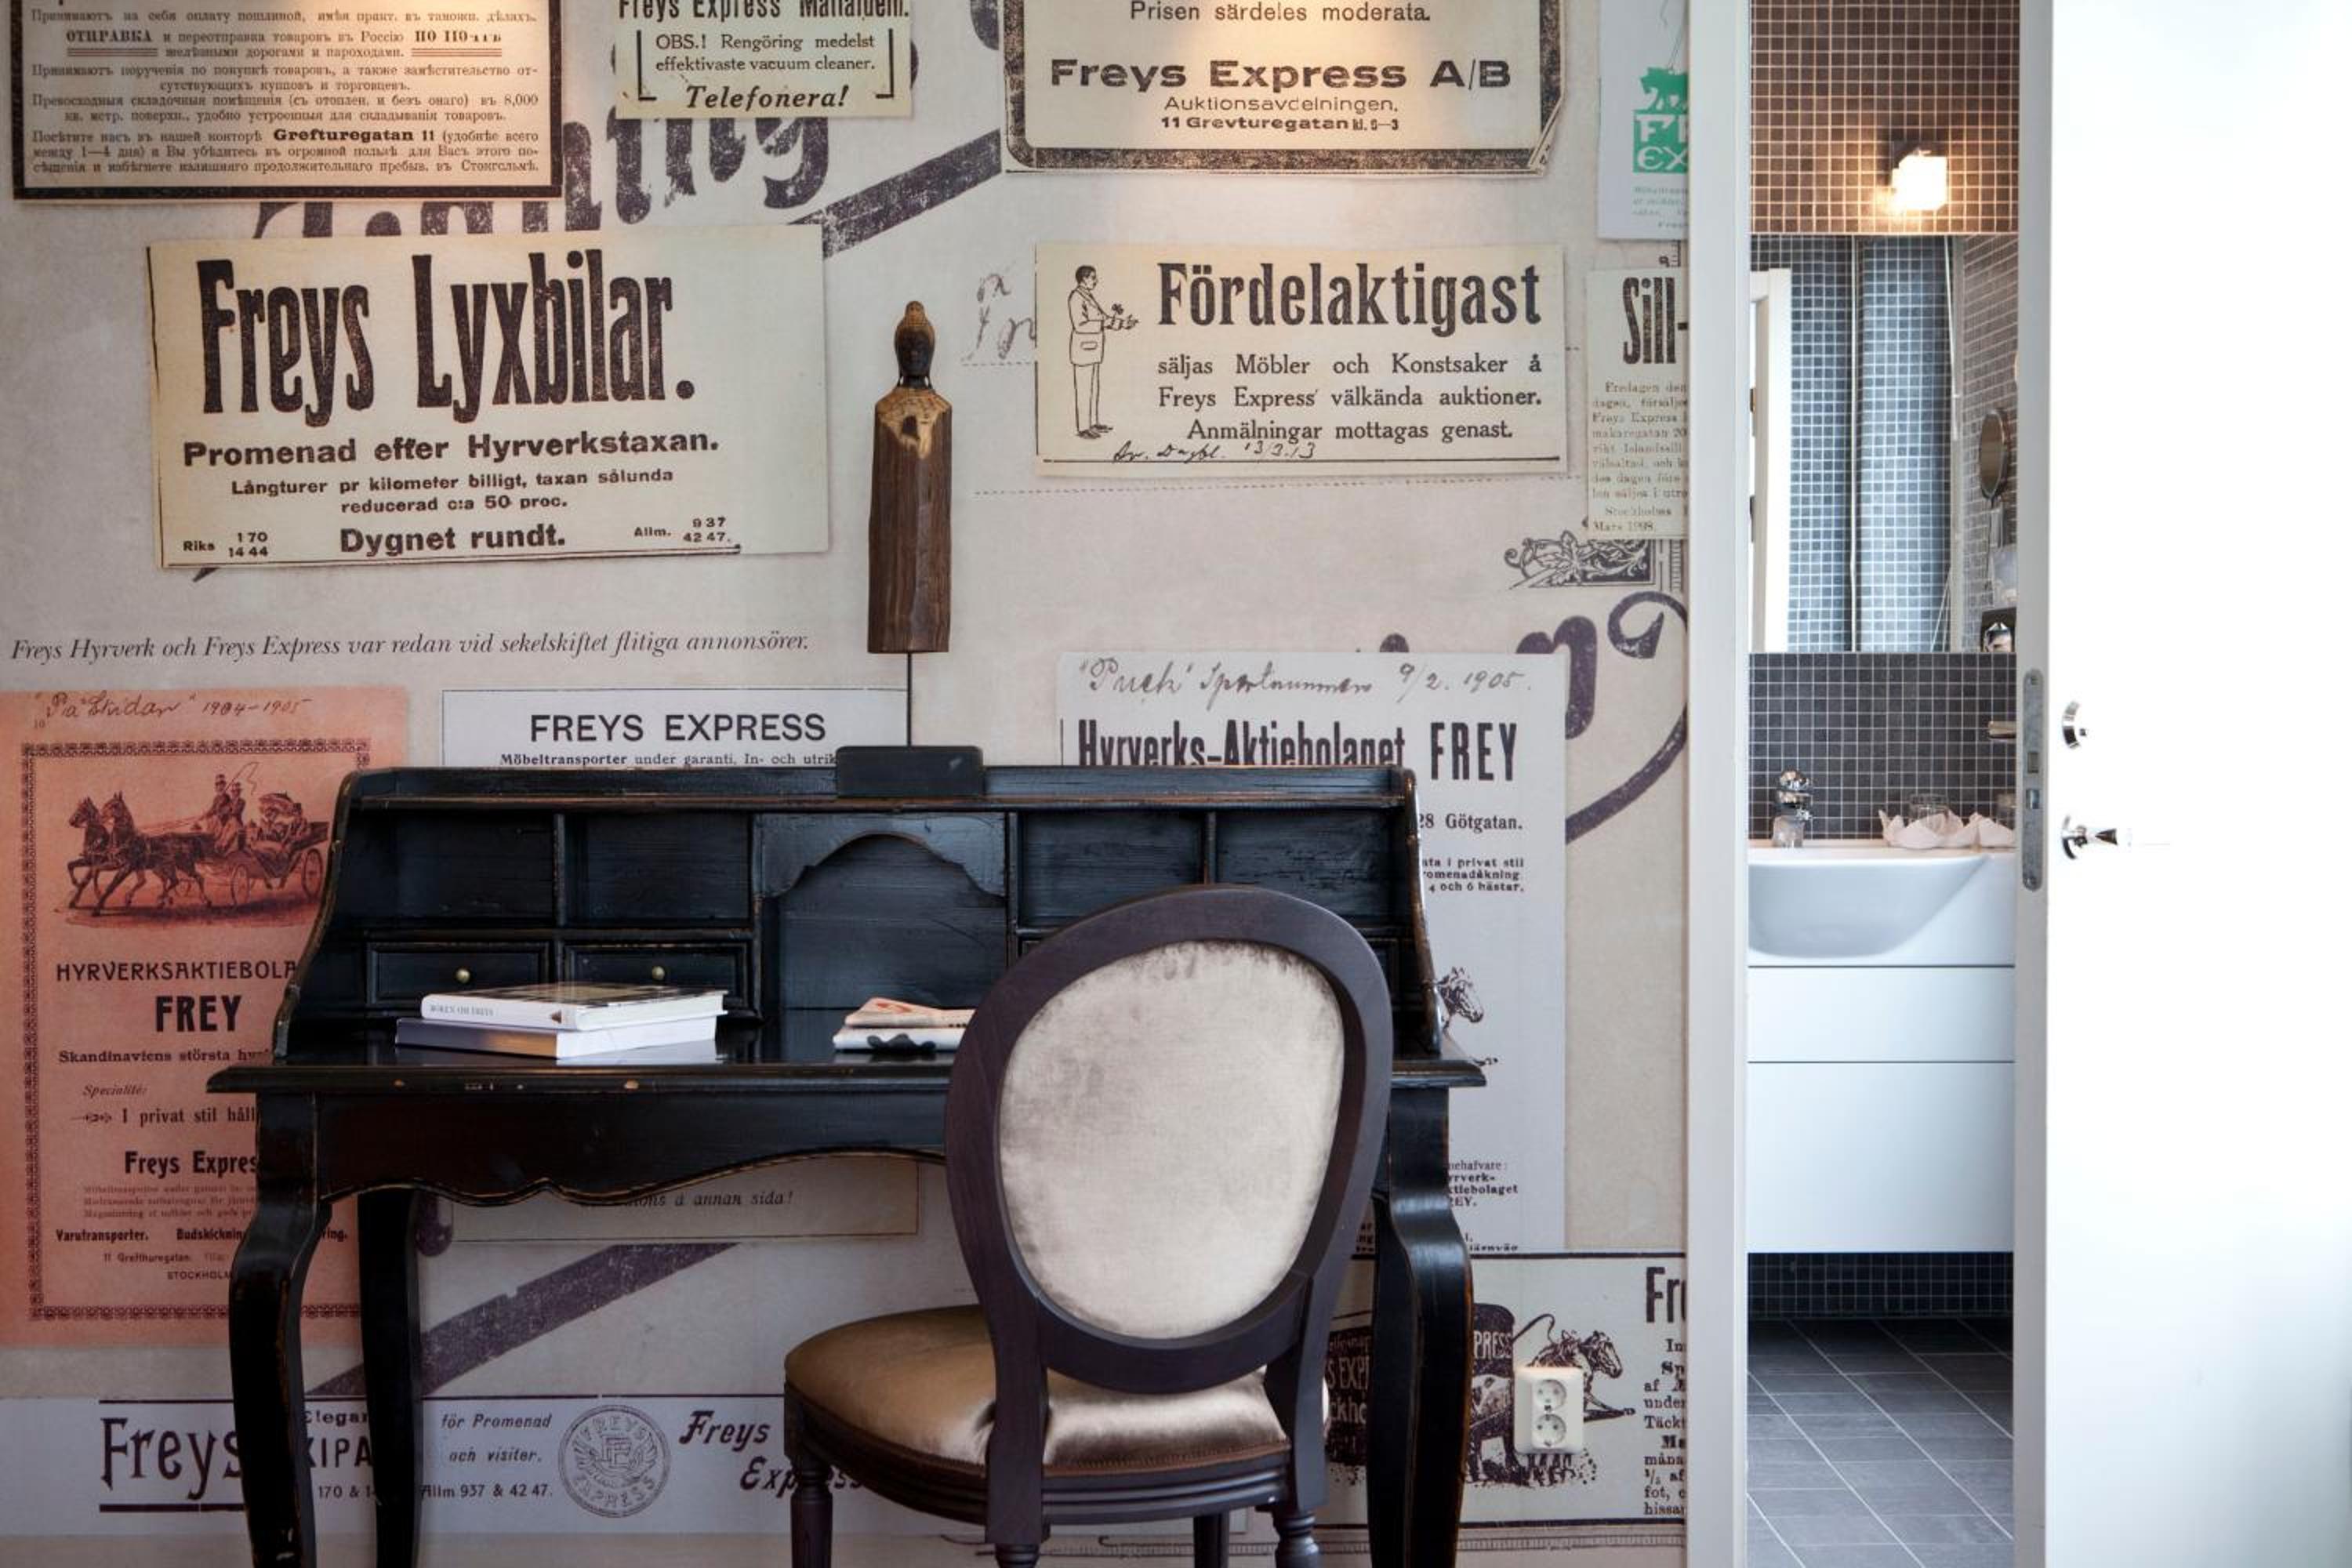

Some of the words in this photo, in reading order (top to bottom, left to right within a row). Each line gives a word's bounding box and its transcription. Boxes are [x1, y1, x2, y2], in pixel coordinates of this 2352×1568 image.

[619, 0, 680, 24] Freys
[692, 0, 781, 23] Express
[1131, 0, 1200, 21] Prisen
[1214, 1, 1308, 21] särdeles
[1322, 1, 1431, 22] moderata.
[65, 29, 153, 43] ОТПРАВКА
[655, 34, 706, 50] OBS.!
[720, 34, 804, 53] Rengöring
[815, 32, 875, 49] medelst
[655, 56, 746, 71] effektivaste
[749, 60, 811, 71] vacuum
[815, 54, 876, 71] cleaner.
[1051, 59, 1187, 93] Freys
[1210, 60, 1407, 94] Express
[1429, 59, 1511, 91] A/B
[503, 93, 539, 108] 8,000
[686, 84, 850, 112] Telefonera!
[1161, 116, 1180, 129] 11
[1185, 116, 1349, 132] Grevturegatan
[273, 129, 414, 143] Grefturegatan
[422, 129, 434, 142] 11
[1156, 262, 1541, 338] Fördelaktigast
[1622, 277, 1688, 365] Sill-
[196, 259, 375, 428] Freys
[412, 248, 696, 425] Lyxbilar.
[1157, 353, 1214, 379] säljas
[1236, 353, 1311, 375] Möbler
[1332, 352, 1370, 375] och
[1392, 351, 1508, 374] Konstsaker
[1528, 353, 1542, 373] å
[1158, 385, 1217, 412] Freys
[1330, 384, 1424, 407] välkända
[1439, 385, 1542, 406] auktioner.
[1186, 418, 1323, 445] Anmälningar
[1335, 421, 1429, 445] mottagas
[1441, 419, 1513, 444] genast.
[183, 437, 357, 467] Promenad
[374, 436, 449, 462] efter
[468, 430, 719, 463] Hyrverkstaxan.
[231, 479, 328, 498] Långturer
[339, 481, 360, 495] pr
[368, 476, 459, 492] kilometer
[468, 473, 528, 491] billigt,
[535, 473, 588, 486] taxan
[597, 468, 673, 484] sålunda
[341, 498, 438, 514] reducerad
[447, 499, 474, 511] c:a
[485, 495, 513, 510] 50
[520, 496, 568, 510] proc.
[183, 540, 216, 552] Riks
[339, 528, 456, 558] Dygnet
[470, 523, 568, 555] rundt.
[11, 639, 62, 666] Freys
[69, 637, 155, 666] Hyrverk
[162, 636, 196, 656] och
[204, 636, 255, 663] Freys
[262, 635, 341, 662] Express
[347, 640, 387, 655] var
[391, 633, 452, 653] redan
[459, 633, 495, 653] vid
[499, 633, 608, 659] sekelskiftet
[614, 634, 680, 660] flitiga
[685, 632, 809, 652] annonsörer.
[531, 713, 644, 742] FREYS
[665, 713, 826, 742] EXPRESS
[499, 753, 628, 767] Möbeltransporter
[634, 753, 677, 765] under
[744, 753, 764, 764] In-
[771, 753, 796, 764] och
[1429, 721, 1518, 782] FREY
[1445, 812, 1523, 833] Götgatan.
[1447, 857, 1451, 868] i
[1457, 857, 1497, 869] privat
[1503, 858, 1524, 868] stil
[1424, 869, 1520, 881] omenadåkning
[1439, 880, 1463, 891] och
[1466, 881, 1475, 891] 6
[1477, 879, 1524, 891] hästar.
[56, 960, 294, 982] HYRVERKSAKTIEBOLA
[155, 994, 242, 1033] FREY
[58, 1050, 172, 1064] Skandinaviens
[179, 1047, 230, 1062] största
[122, 1107, 128, 1124] I
[139, 1107, 185, 1127] privat
[194, 1106, 217, 1123] stil
[125, 1150, 181, 1179] Freys
[192, 1151, 257, 1178] Expres
[56, 1229, 149, 1245] Varutransporter.
[176, 1229, 244, 1244] Budskicknin
[1473, 1330, 1512, 1359] PRESS
[441, 1413, 465, 1430] för
[472, 1413, 553, 1430] Promenad
[678, 1410, 771, 1452] Freys
[100, 1416, 240, 1501] Freys
[448, 1446, 477, 1463] och
[487, 1446, 542, 1462] visiter.
[349, 1485, 360, 1498] &
[459, 1483, 485, 1498] 937
[492, 1483, 504, 1498] &
